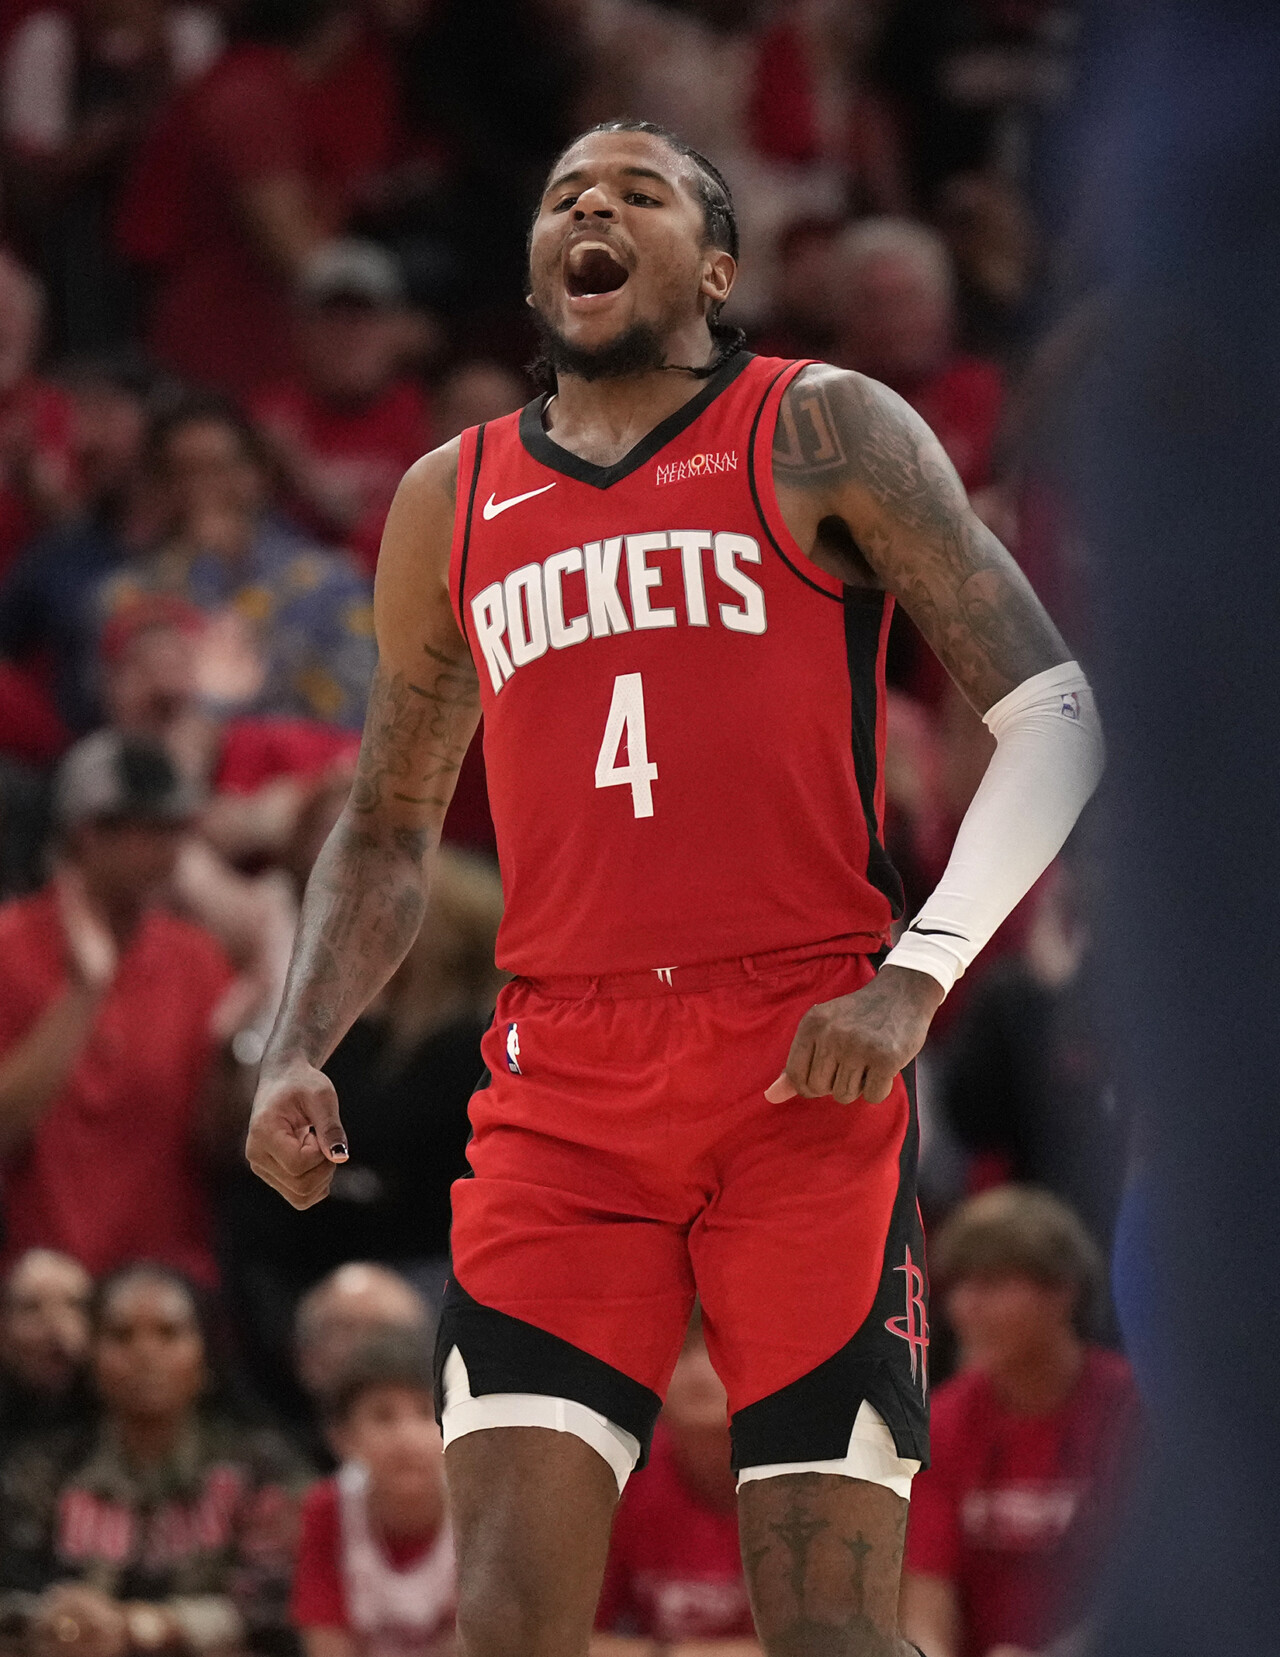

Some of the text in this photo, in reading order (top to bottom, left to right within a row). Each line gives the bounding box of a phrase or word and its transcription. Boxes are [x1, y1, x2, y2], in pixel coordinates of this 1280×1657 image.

[656, 450, 738, 475] MEMORIAL
[656, 458, 738, 486] HERMANN
[470, 530, 767, 695] ROCKETS
[594, 672, 659, 819] 4
